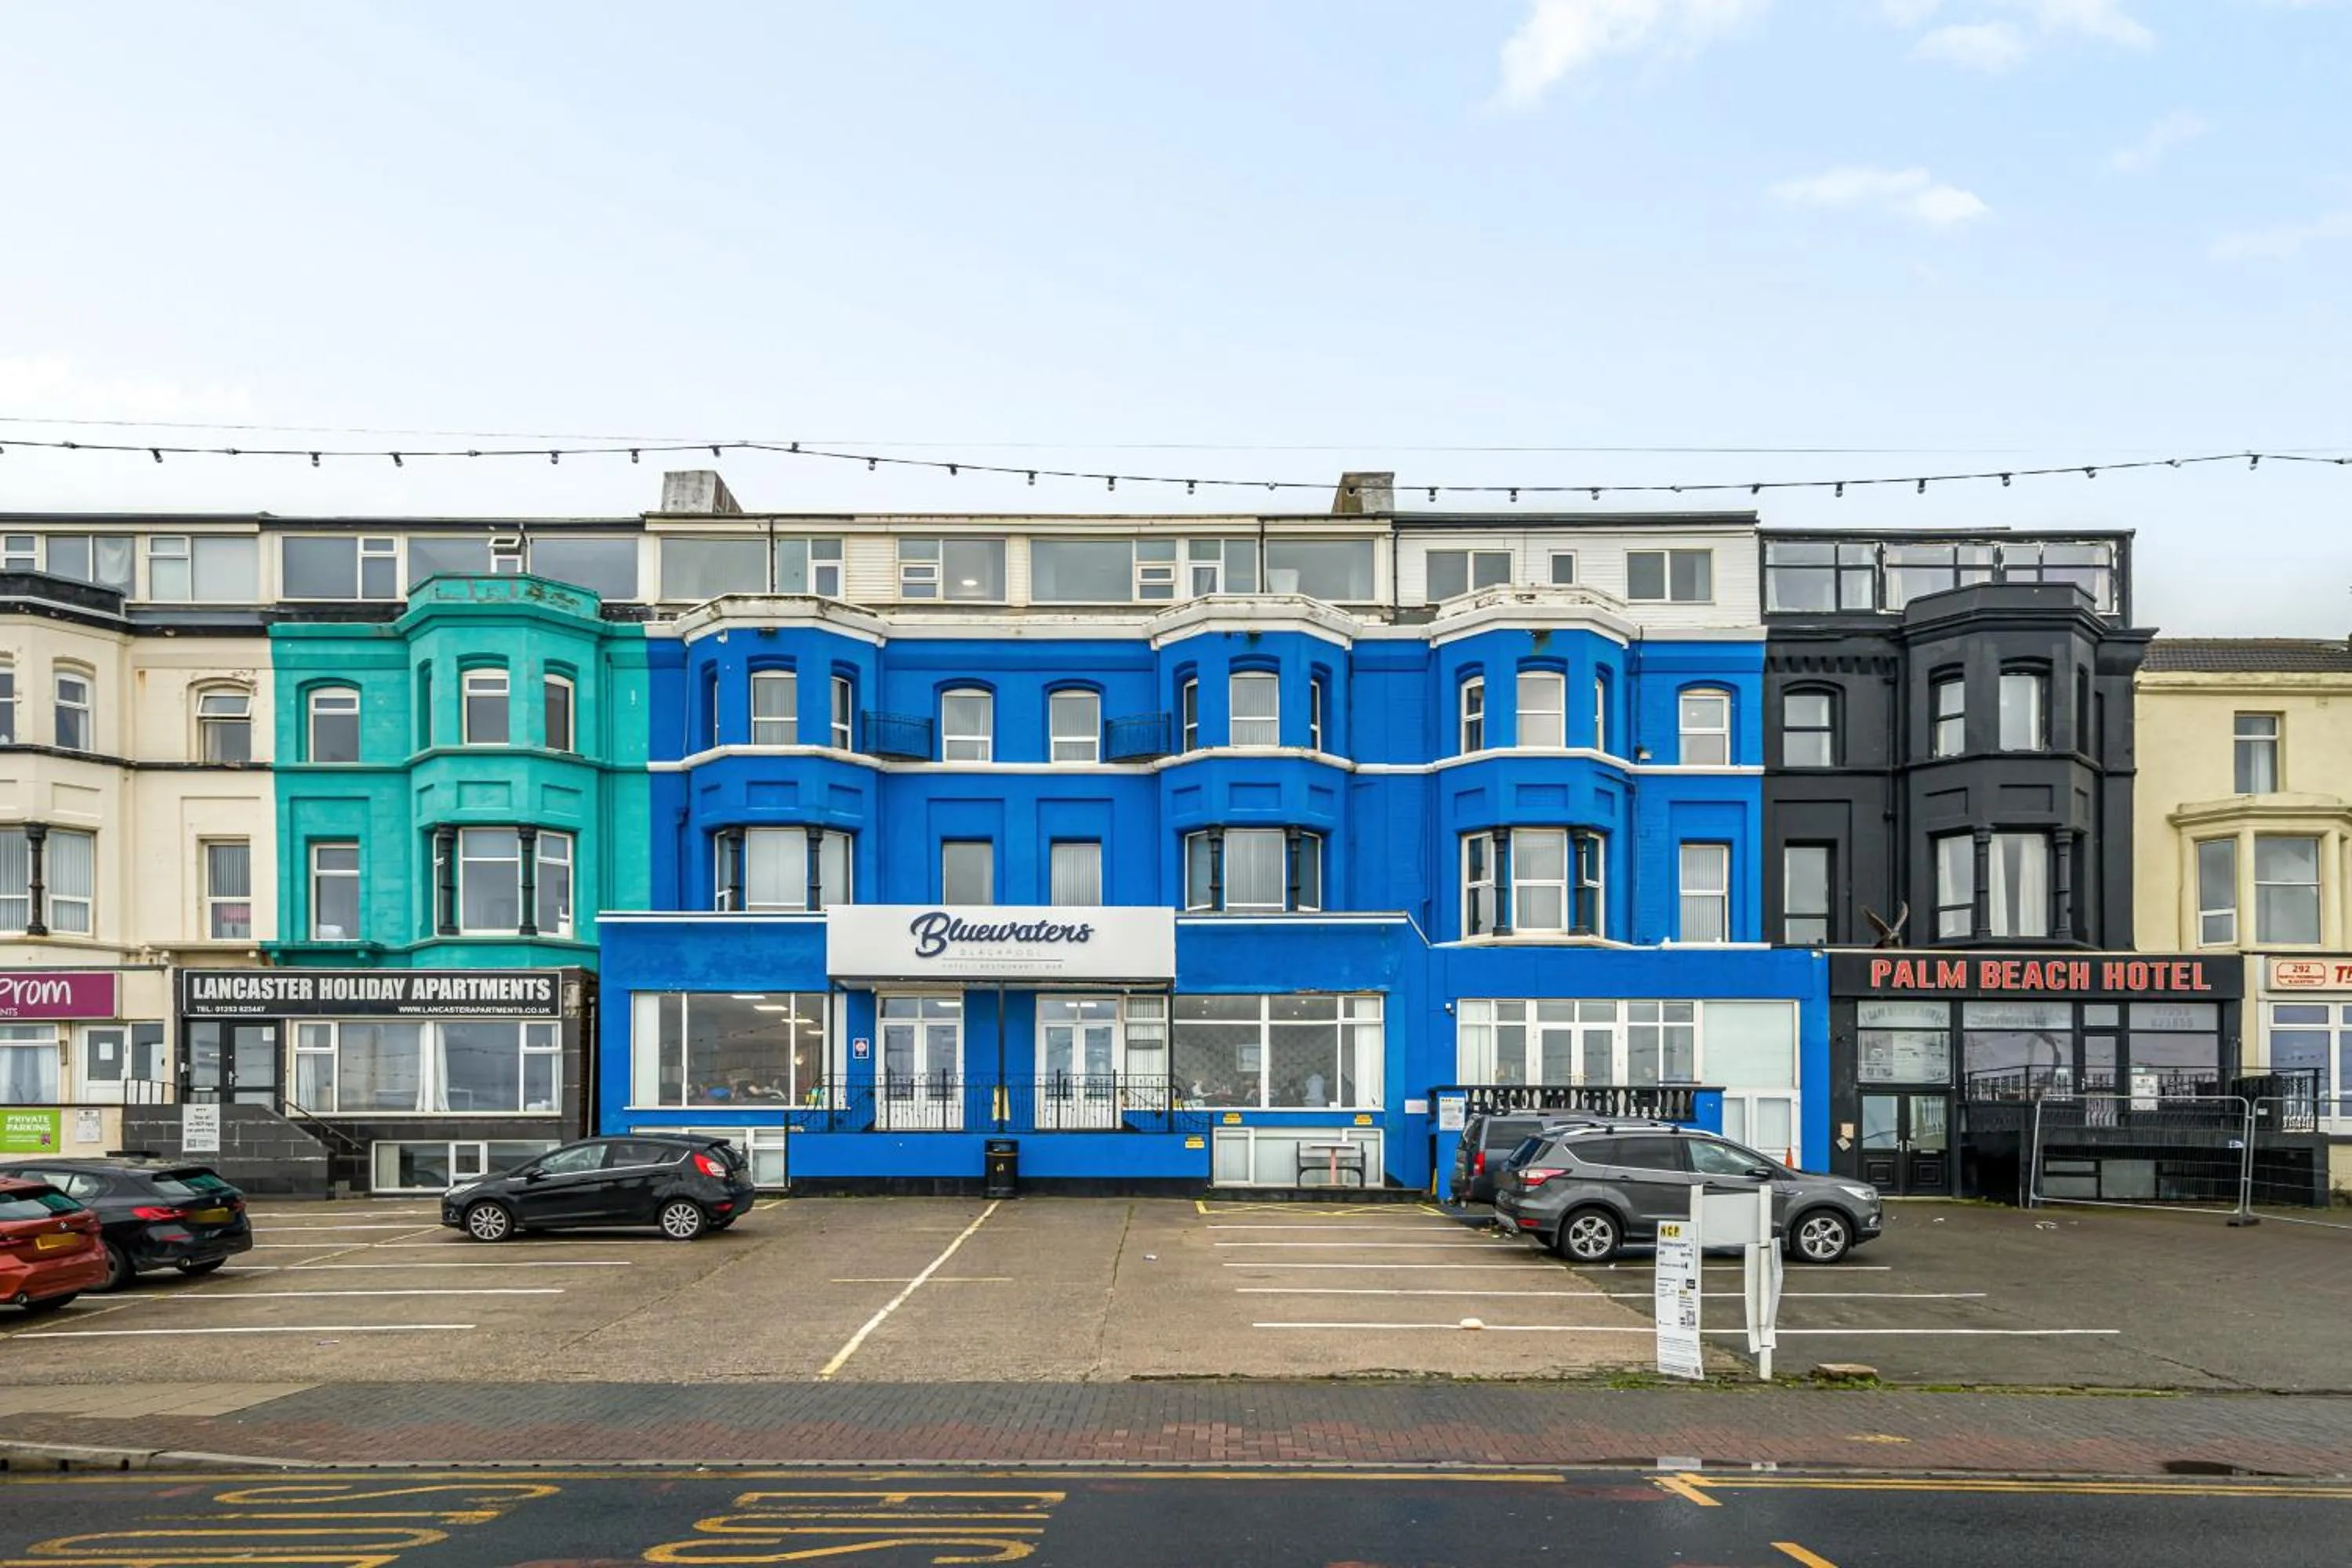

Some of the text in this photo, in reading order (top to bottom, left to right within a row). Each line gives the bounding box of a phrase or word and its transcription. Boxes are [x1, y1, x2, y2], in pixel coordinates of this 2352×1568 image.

[910, 912, 1095, 957] Bluewaters
[1870, 958, 2212, 991] PALM BEACH HOTEL
[193, 978, 552, 1001] LANCASTER HOLIDAY APARTMENTS
[397, 1006, 551, 1014] WWW.LANCASTERAPARTMENTS.CO.UK
[7, 1115, 50, 1123] PRIVATE
[5, 1123, 51, 1132] PARKING
